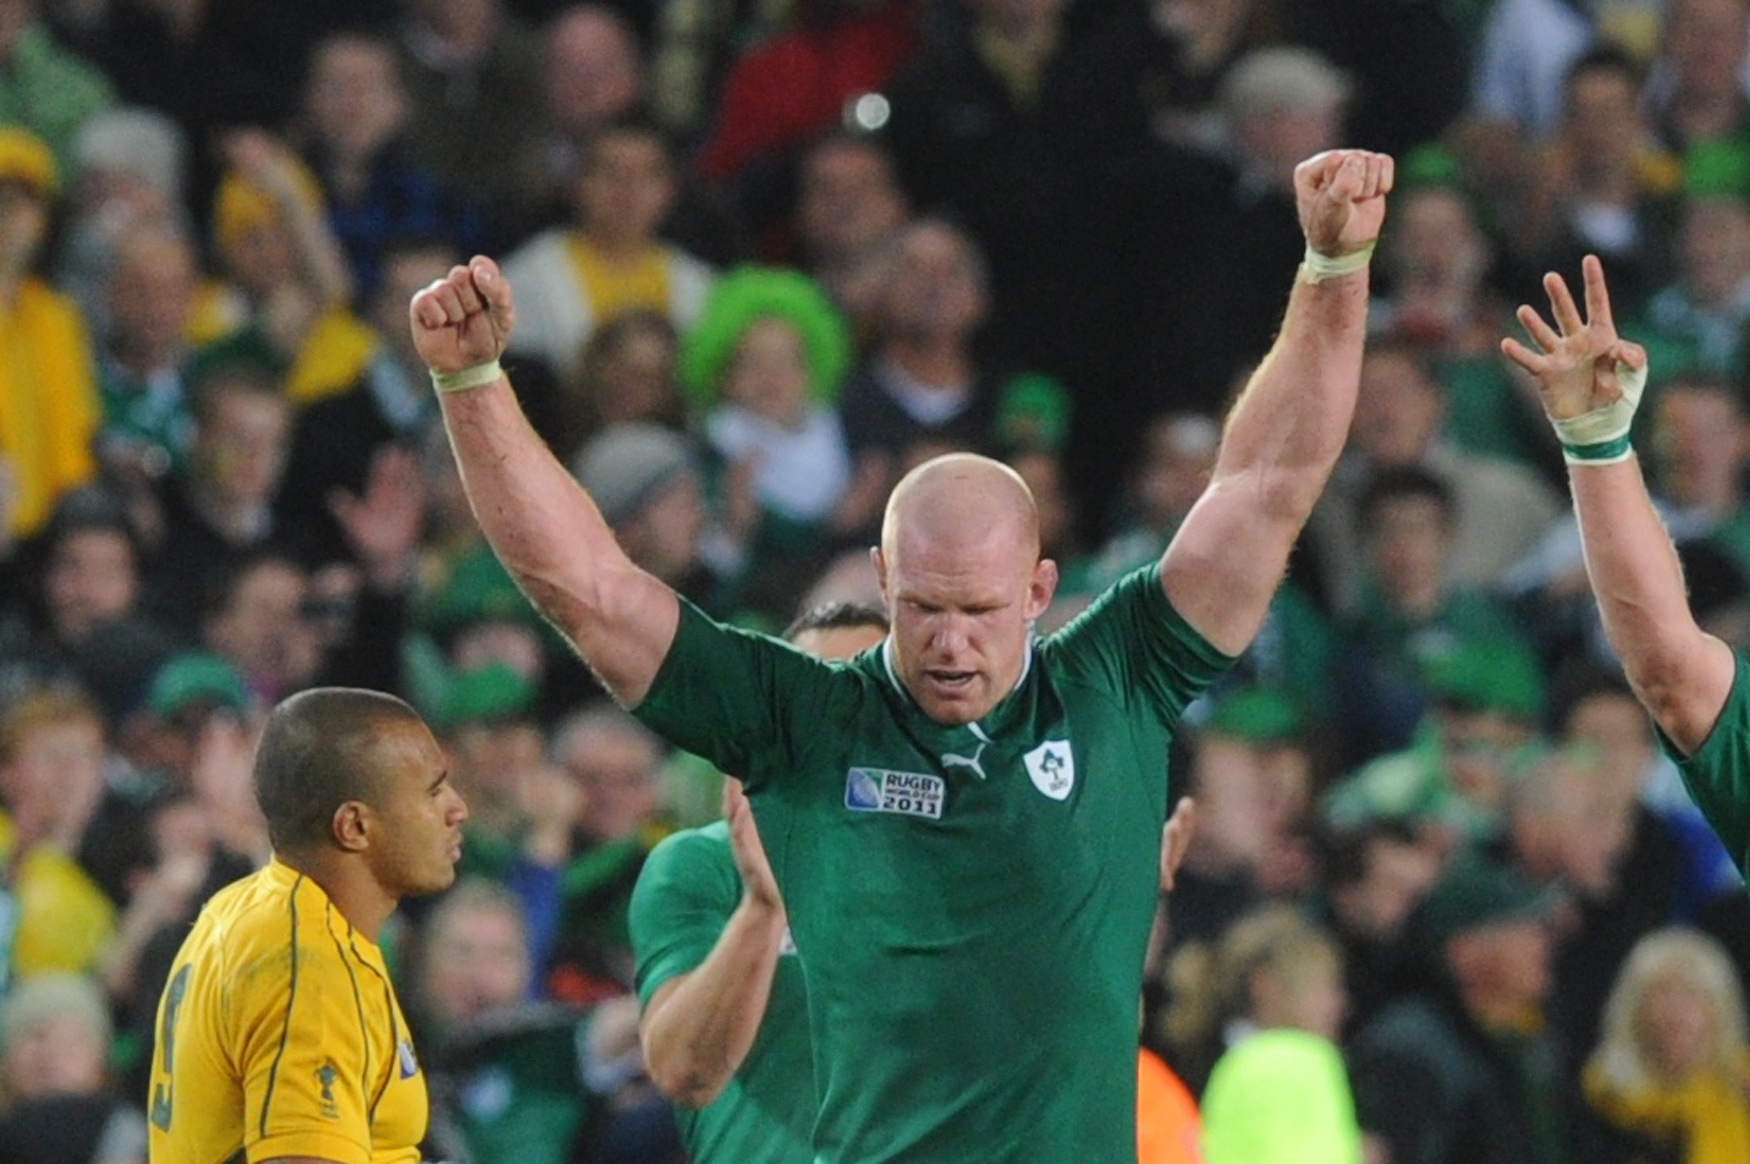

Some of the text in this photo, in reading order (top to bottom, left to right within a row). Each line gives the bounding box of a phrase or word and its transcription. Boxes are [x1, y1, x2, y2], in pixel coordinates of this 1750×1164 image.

[886, 773, 941, 791] RUGBY
[885, 787, 941, 800] WORLD CUP
[883, 796, 937, 814] 2011
